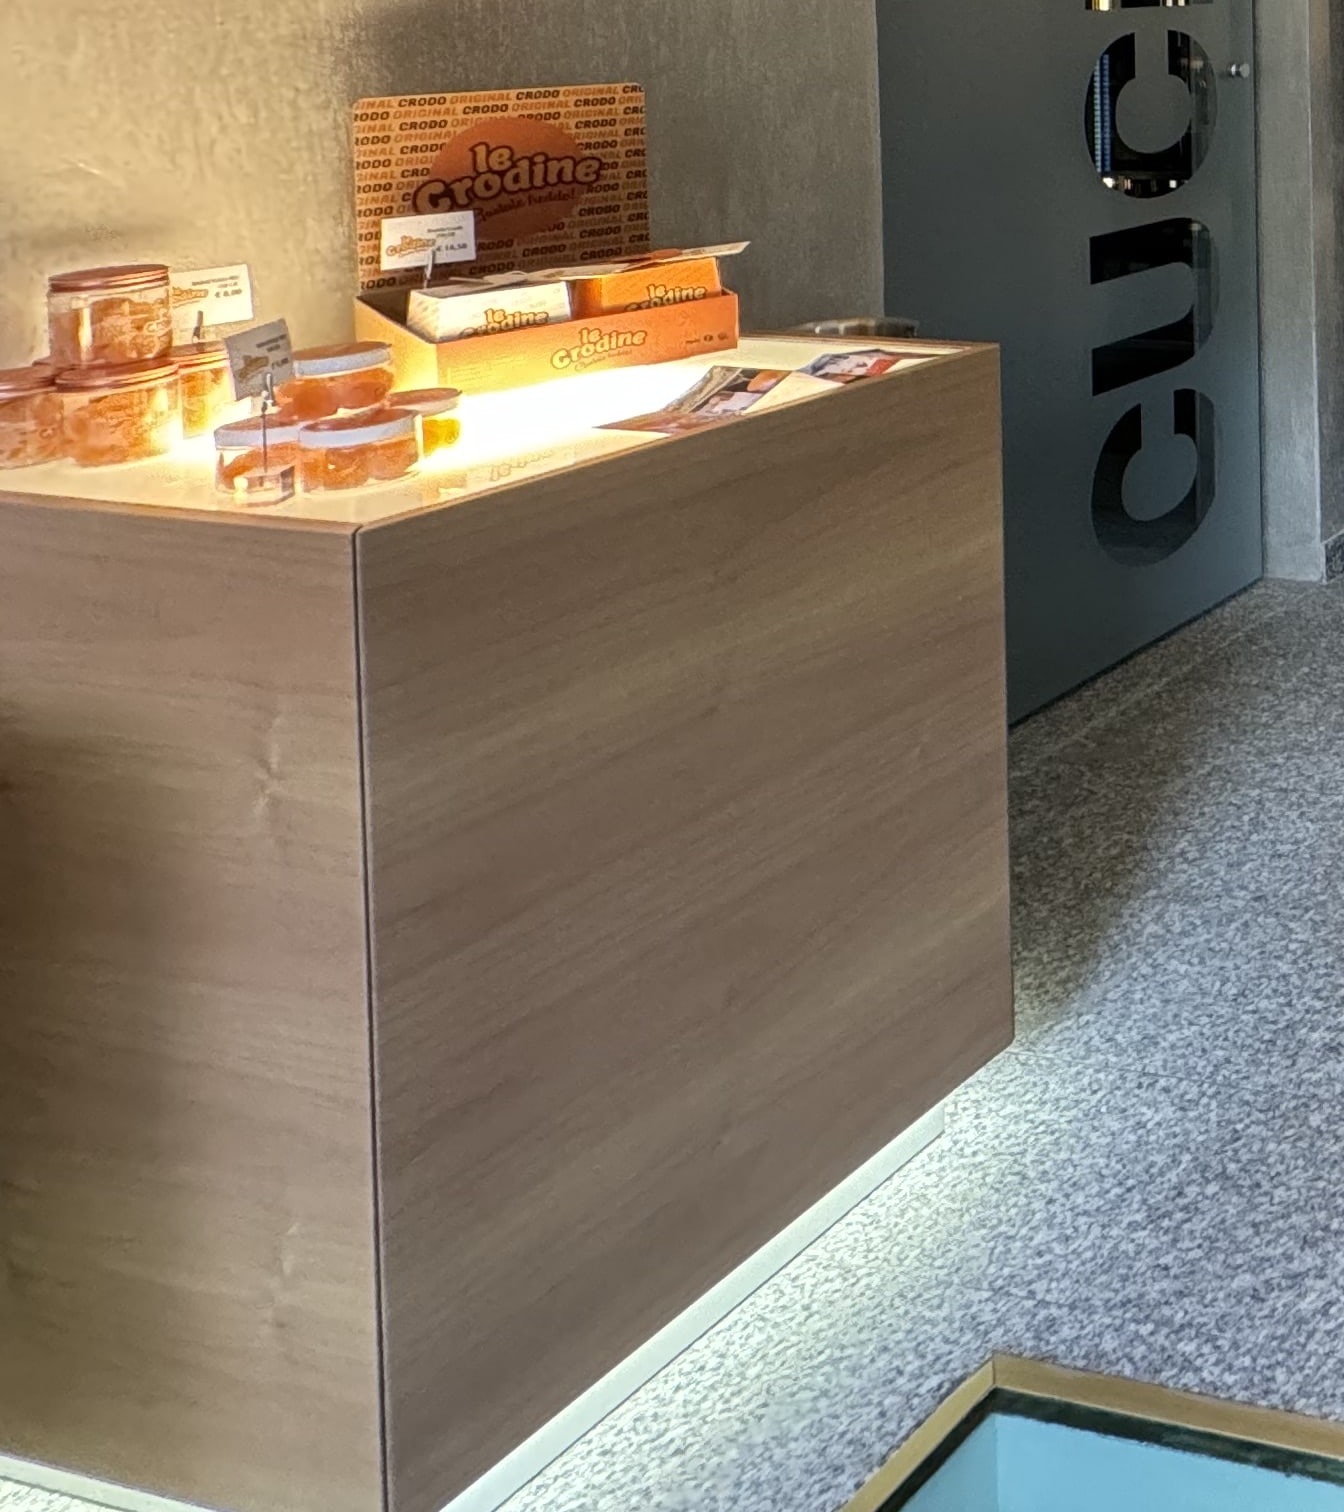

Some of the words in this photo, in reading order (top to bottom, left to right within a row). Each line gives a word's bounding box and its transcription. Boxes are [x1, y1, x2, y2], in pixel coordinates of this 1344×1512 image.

[397, 96, 447, 108] CRODO
[450, 92, 512, 105] ORIGINAL
[516, 90, 560, 101] CRODO
[562, 86, 619, 98] ORIGINAL
[393, 106, 459, 119] ORIGINAL
[462, 103, 509, 115] CRODO
[511, 99, 570, 112] ORIGINAL
[574, 96, 616, 108] CRODO
[399, 119, 448, 131] CRODO
[563, 107, 620, 120] ORIGINAL
[575, 118, 617, 130] CRODO
[466, 141, 514, 175] le
[647, 283, 667, 299] le
[484, 308, 506, 324] le
[579, 327, 601, 345] le
